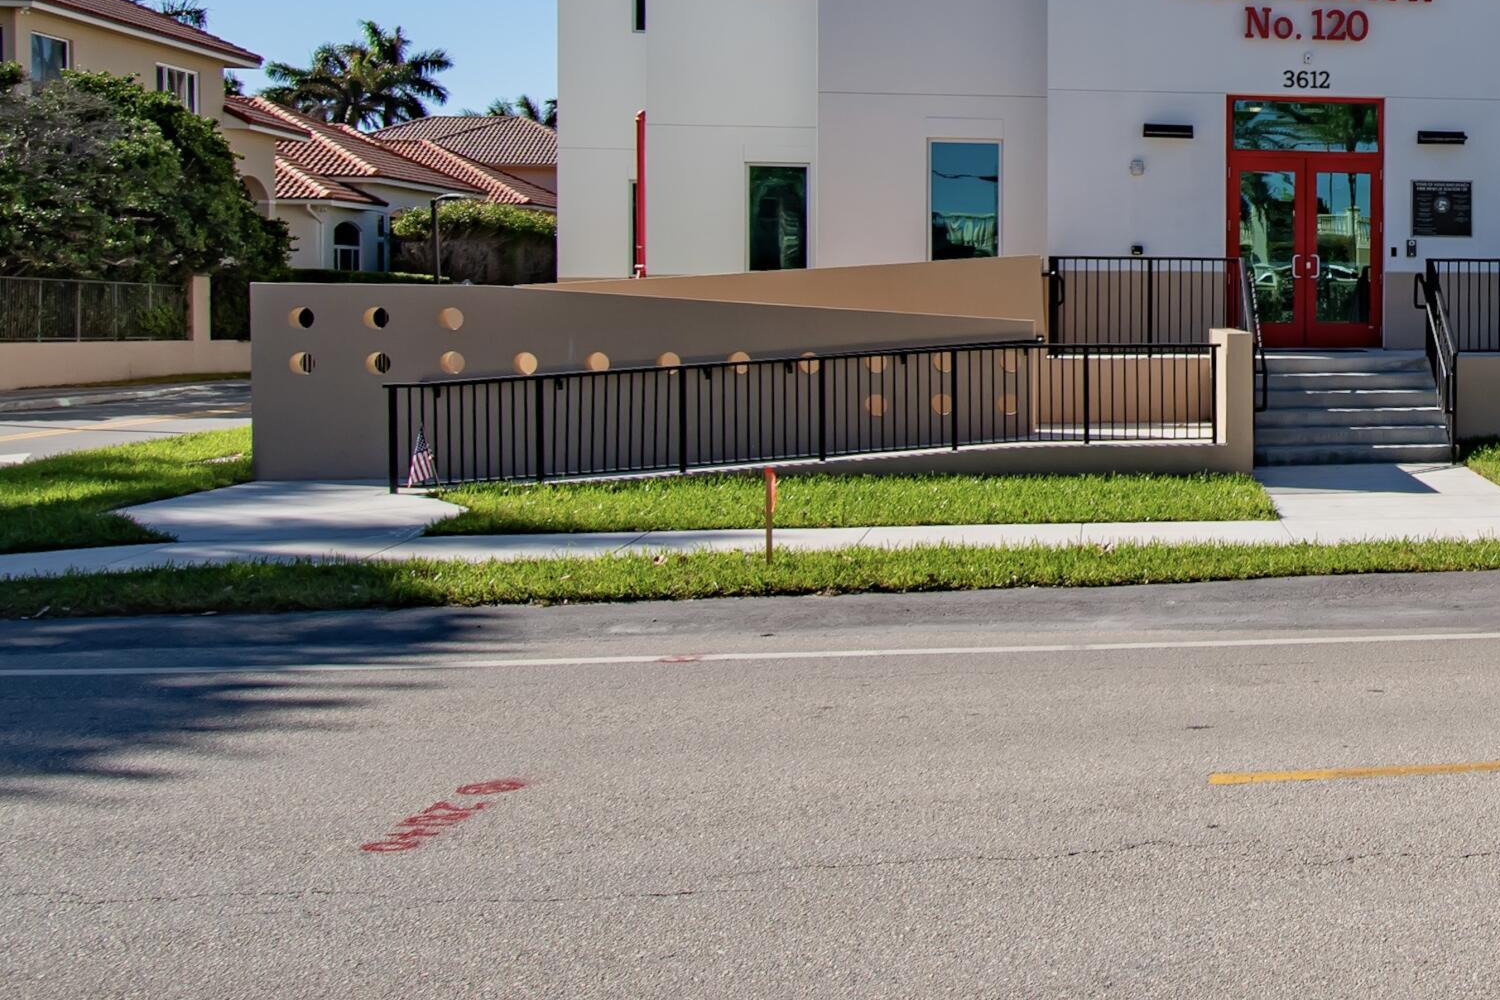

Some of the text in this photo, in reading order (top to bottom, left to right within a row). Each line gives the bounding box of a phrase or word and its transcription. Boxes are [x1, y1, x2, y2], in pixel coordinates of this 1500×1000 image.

[1244, 6, 1369, 41] No. 120
[1282, 70, 1331, 89] 3612
